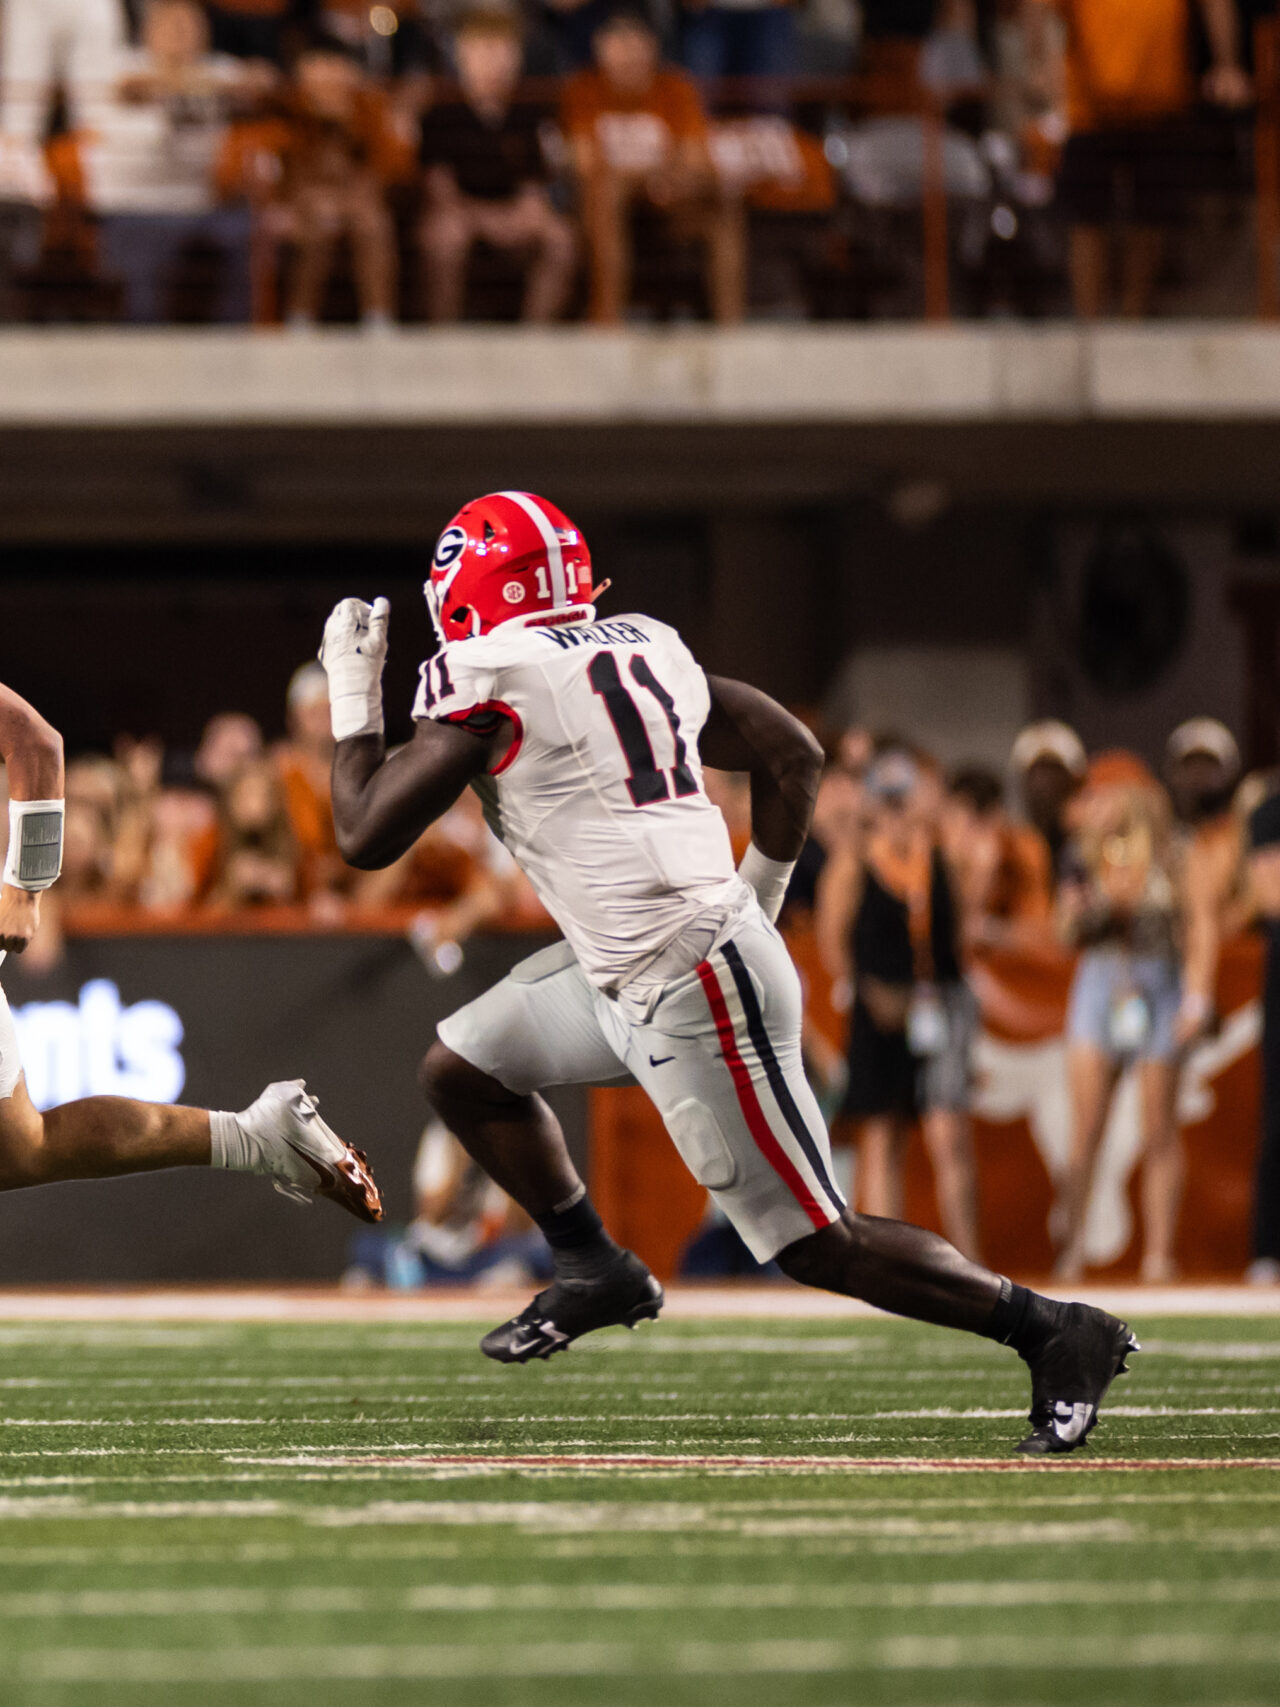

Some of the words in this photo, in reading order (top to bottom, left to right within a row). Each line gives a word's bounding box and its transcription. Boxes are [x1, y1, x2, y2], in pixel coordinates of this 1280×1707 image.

[434, 528, 466, 569] G
[535, 622, 651, 649] WALKER
[424, 651, 456, 711] 11
[587, 651, 700, 807] 11
